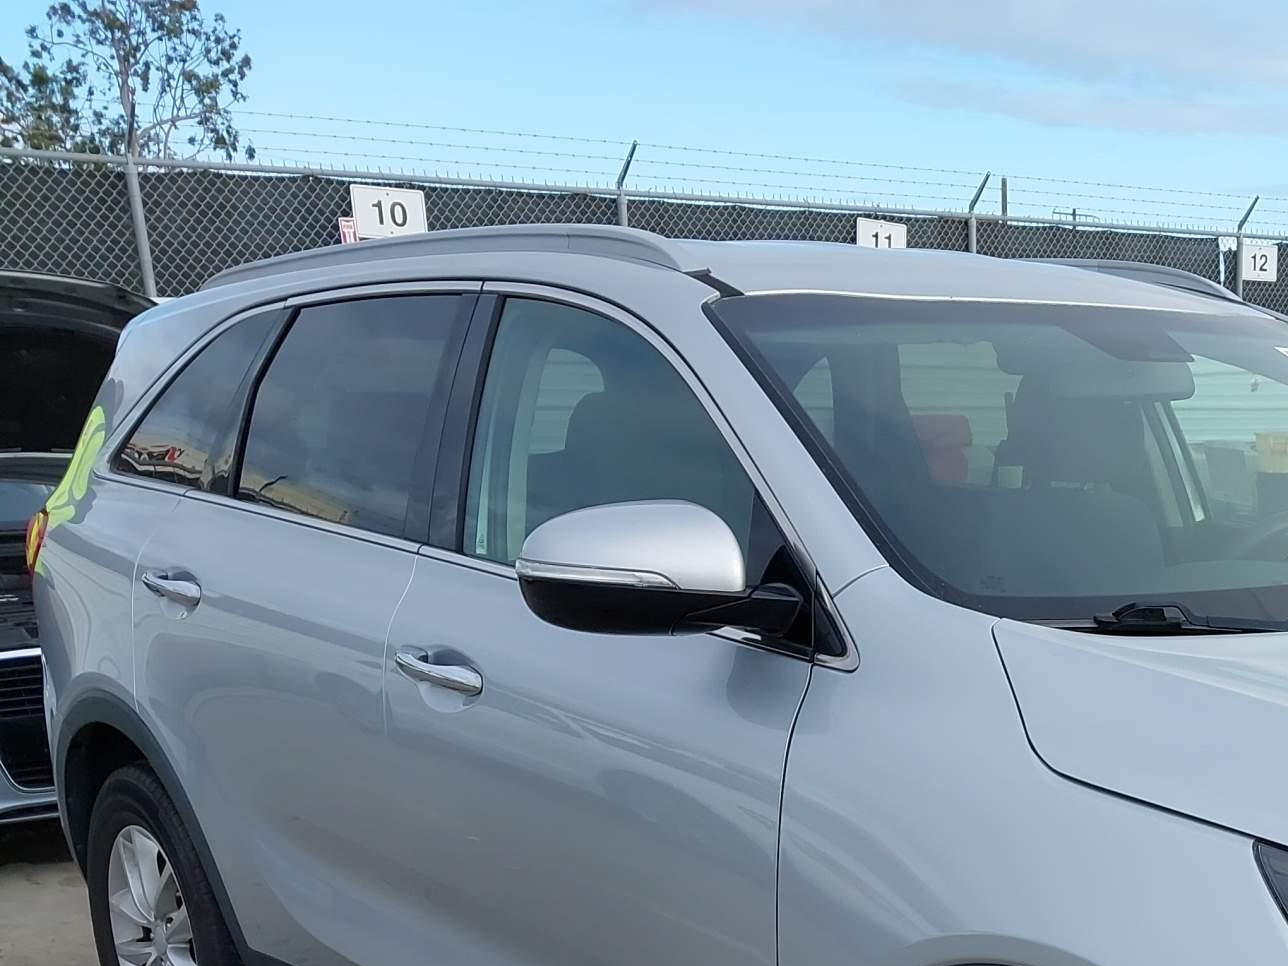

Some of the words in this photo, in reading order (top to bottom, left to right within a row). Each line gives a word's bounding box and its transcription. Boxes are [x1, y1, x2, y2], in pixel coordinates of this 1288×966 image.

[371, 200, 408, 228] 10
[871, 231, 892, 249] 11
[1250, 252, 1268, 272] 12
